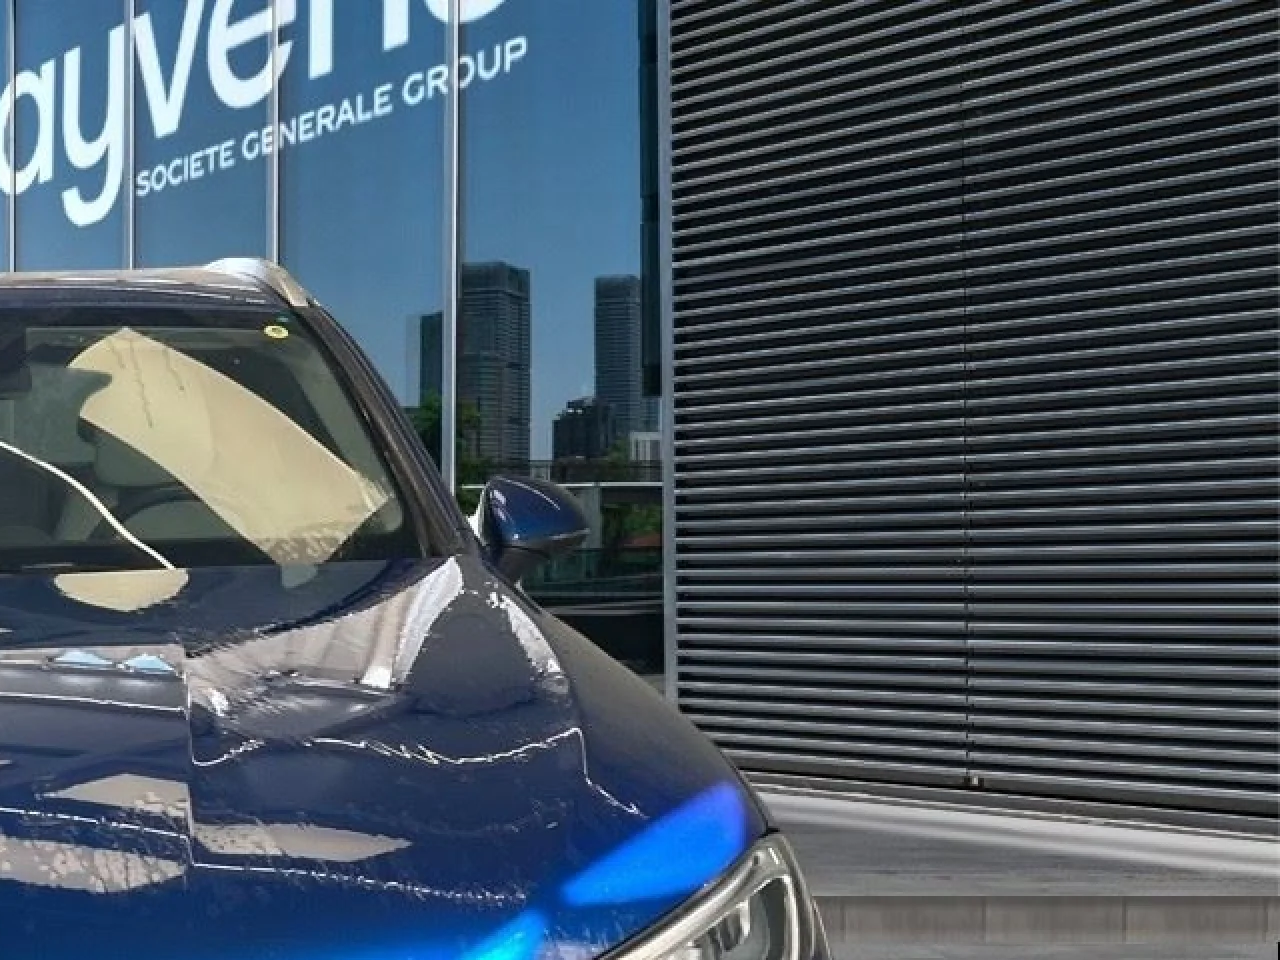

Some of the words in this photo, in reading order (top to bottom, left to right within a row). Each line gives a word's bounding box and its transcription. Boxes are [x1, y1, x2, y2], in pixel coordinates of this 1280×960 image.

[136, 139, 237, 197] SOCIETE
[241, 83, 394, 161] GENERALE
[402, 36, 528, 106] GROUP
